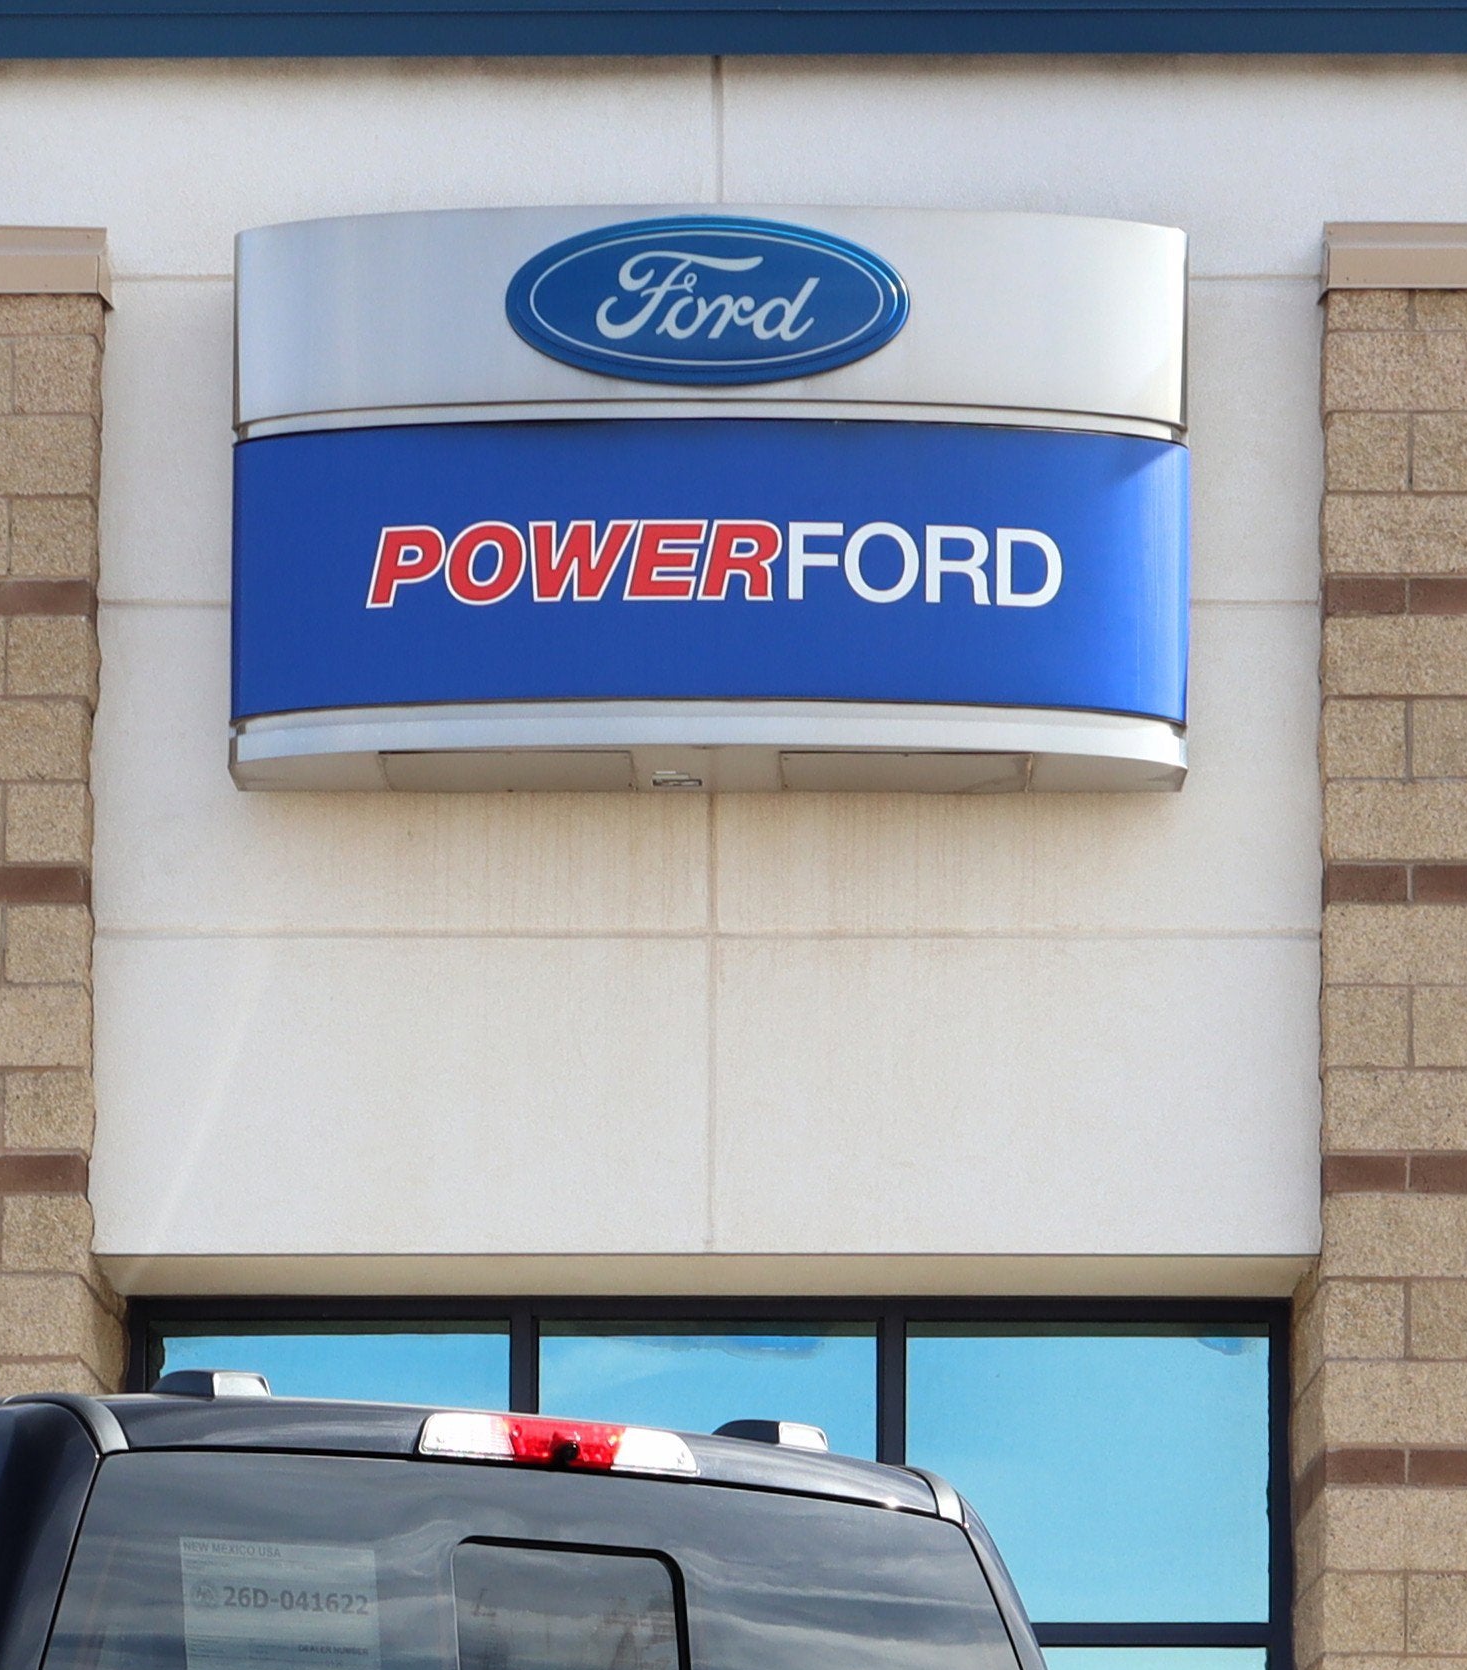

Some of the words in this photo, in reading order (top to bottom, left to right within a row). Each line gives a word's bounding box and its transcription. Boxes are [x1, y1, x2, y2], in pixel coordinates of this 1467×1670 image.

[595, 249, 821, 344] Ford
[364, 519, 1064, 609] POWERFORD
[183, 1541, 209, 1552] NEW
[211, 1542, 256, 1556] MEXICO
[258, 1546, 282, 1558] USA
[222, 1585, 370, 1616] 26D-041622
